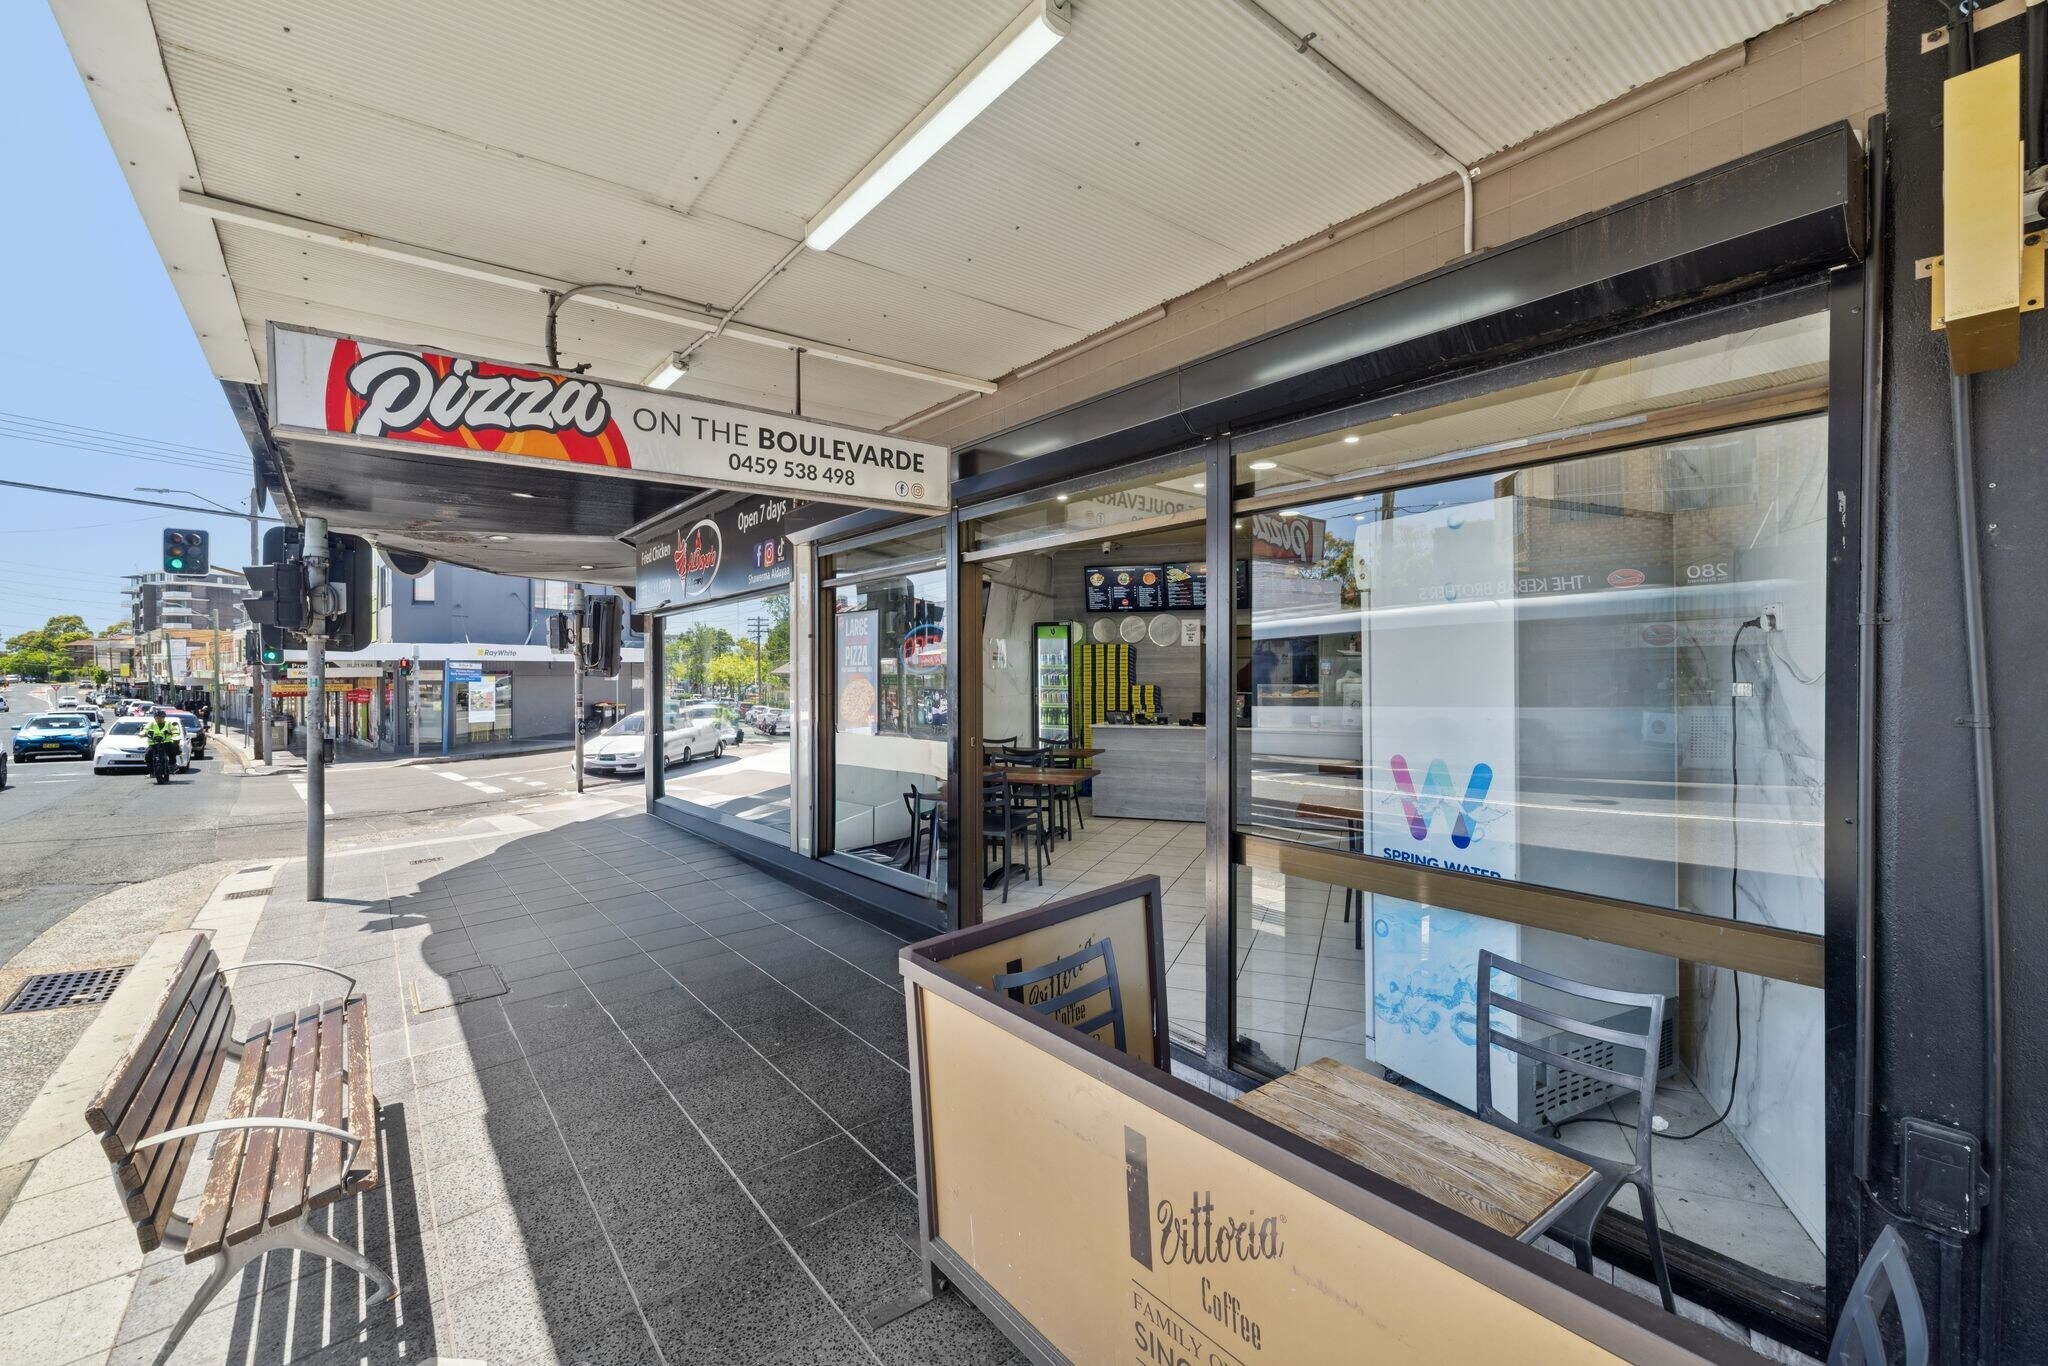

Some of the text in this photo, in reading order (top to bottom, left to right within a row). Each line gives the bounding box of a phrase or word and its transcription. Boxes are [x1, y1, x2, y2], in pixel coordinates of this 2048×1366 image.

[348, 350, 608, 438] Pizza
[632, 407, 925, 473] ON THE BOULEVARDE
[728, 453, 856, 486] 0459 538 498
[737, 511, 759, 533] Open
[759, 503, 765, 523] 7
[766, 499, 787, 522] days
[641, 543, 671, 567] Fried Chicken
[845, 618, 869, 636] LARGE
[844, 644, 868, 666] PIZZA
[1383, 847, 1440, 868] SPRING
[1157, 1190, 1284, 1265] Vittoria
[1132, 1291, 1203, 1360] FAMILY
[1201, 1276, 1262, 1350] Coffee
